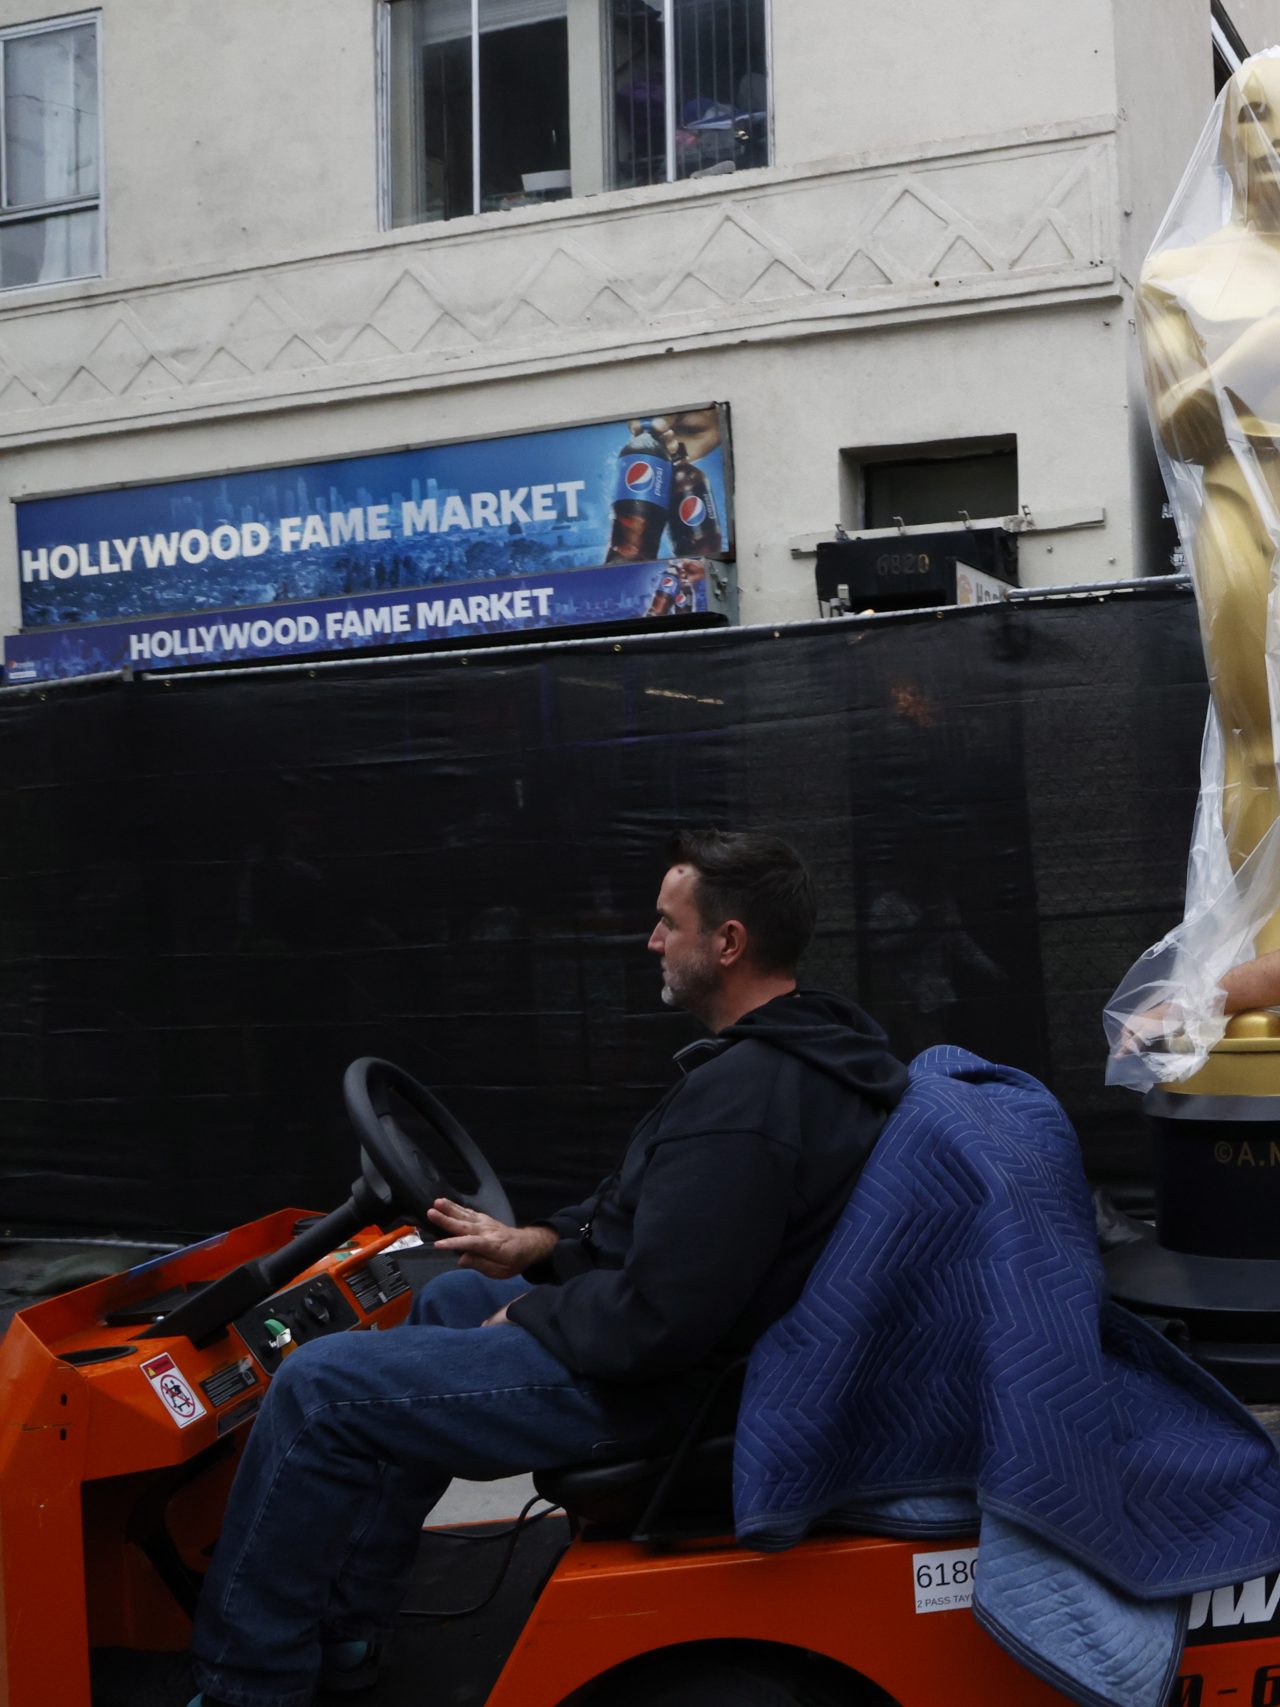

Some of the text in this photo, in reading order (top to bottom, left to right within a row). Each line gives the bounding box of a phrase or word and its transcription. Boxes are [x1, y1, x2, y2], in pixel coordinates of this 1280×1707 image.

[21, 480, 585, 583] HOLLYWOOD FAME MARKET
[877, 553, 930, 576] 6820
[130, 587, 554, 660] HOLLYWOOD FAME MARKET
[917, 1599, 923, 1608] 2
[925, 1596, 951, 1607] PASS
